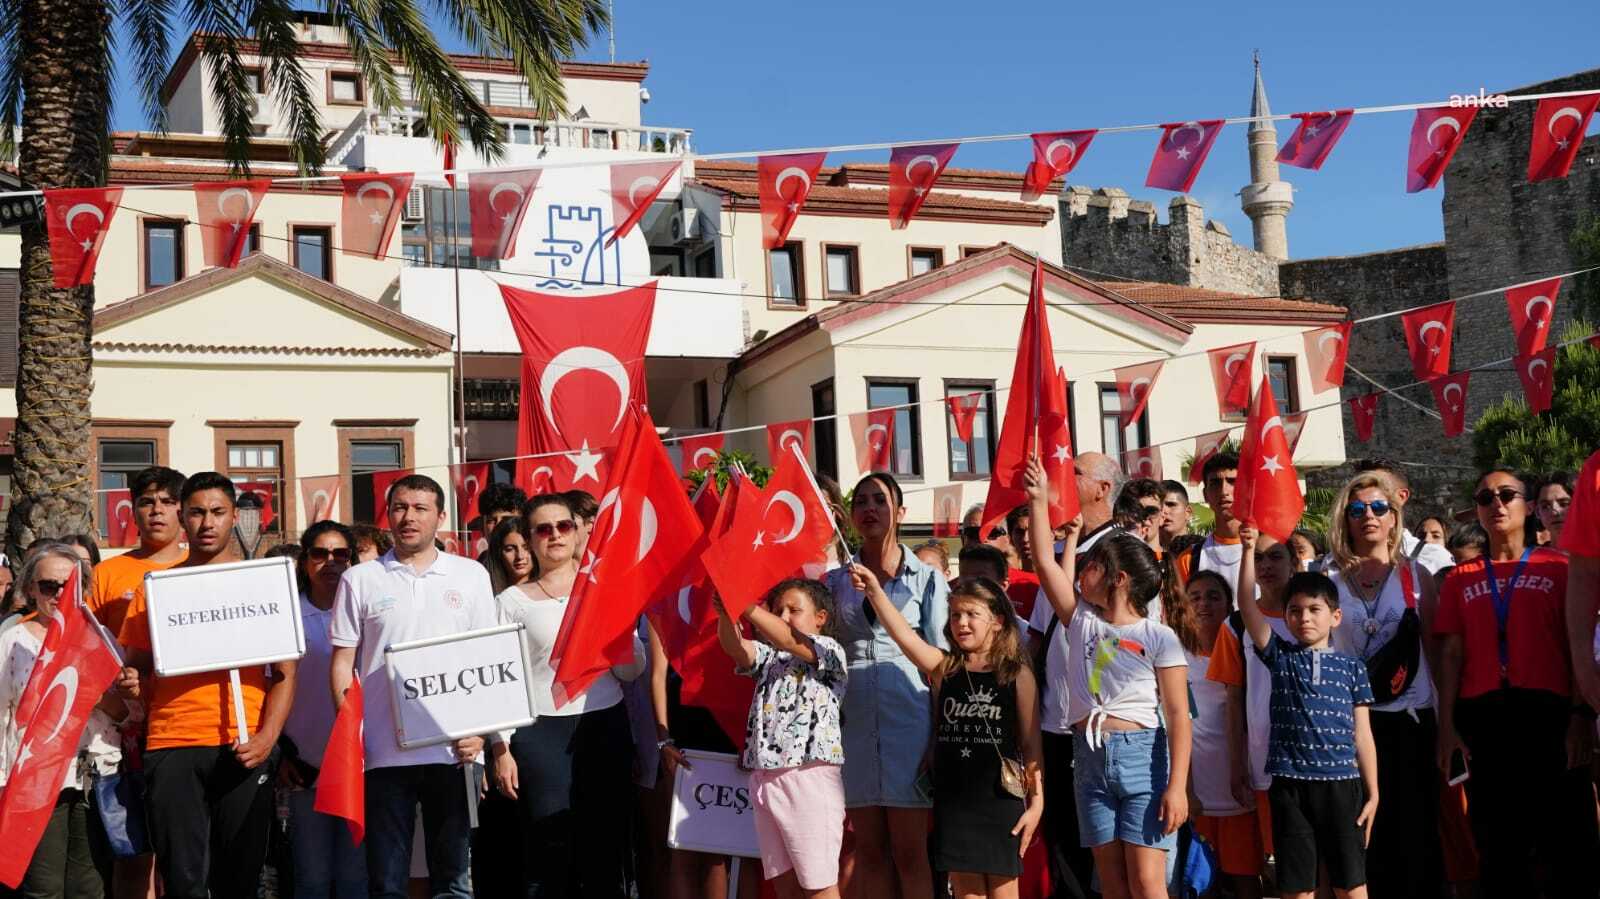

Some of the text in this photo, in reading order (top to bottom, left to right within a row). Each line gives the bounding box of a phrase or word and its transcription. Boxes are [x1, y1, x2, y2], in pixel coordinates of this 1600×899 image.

[167, 602, 280, 627] SEFERİHİSAR
[403, 661, 519, 700] SELÇUK
[943, 696, 1002, 724] Queen
[694, 783, 754, 815] ÇEŞ
